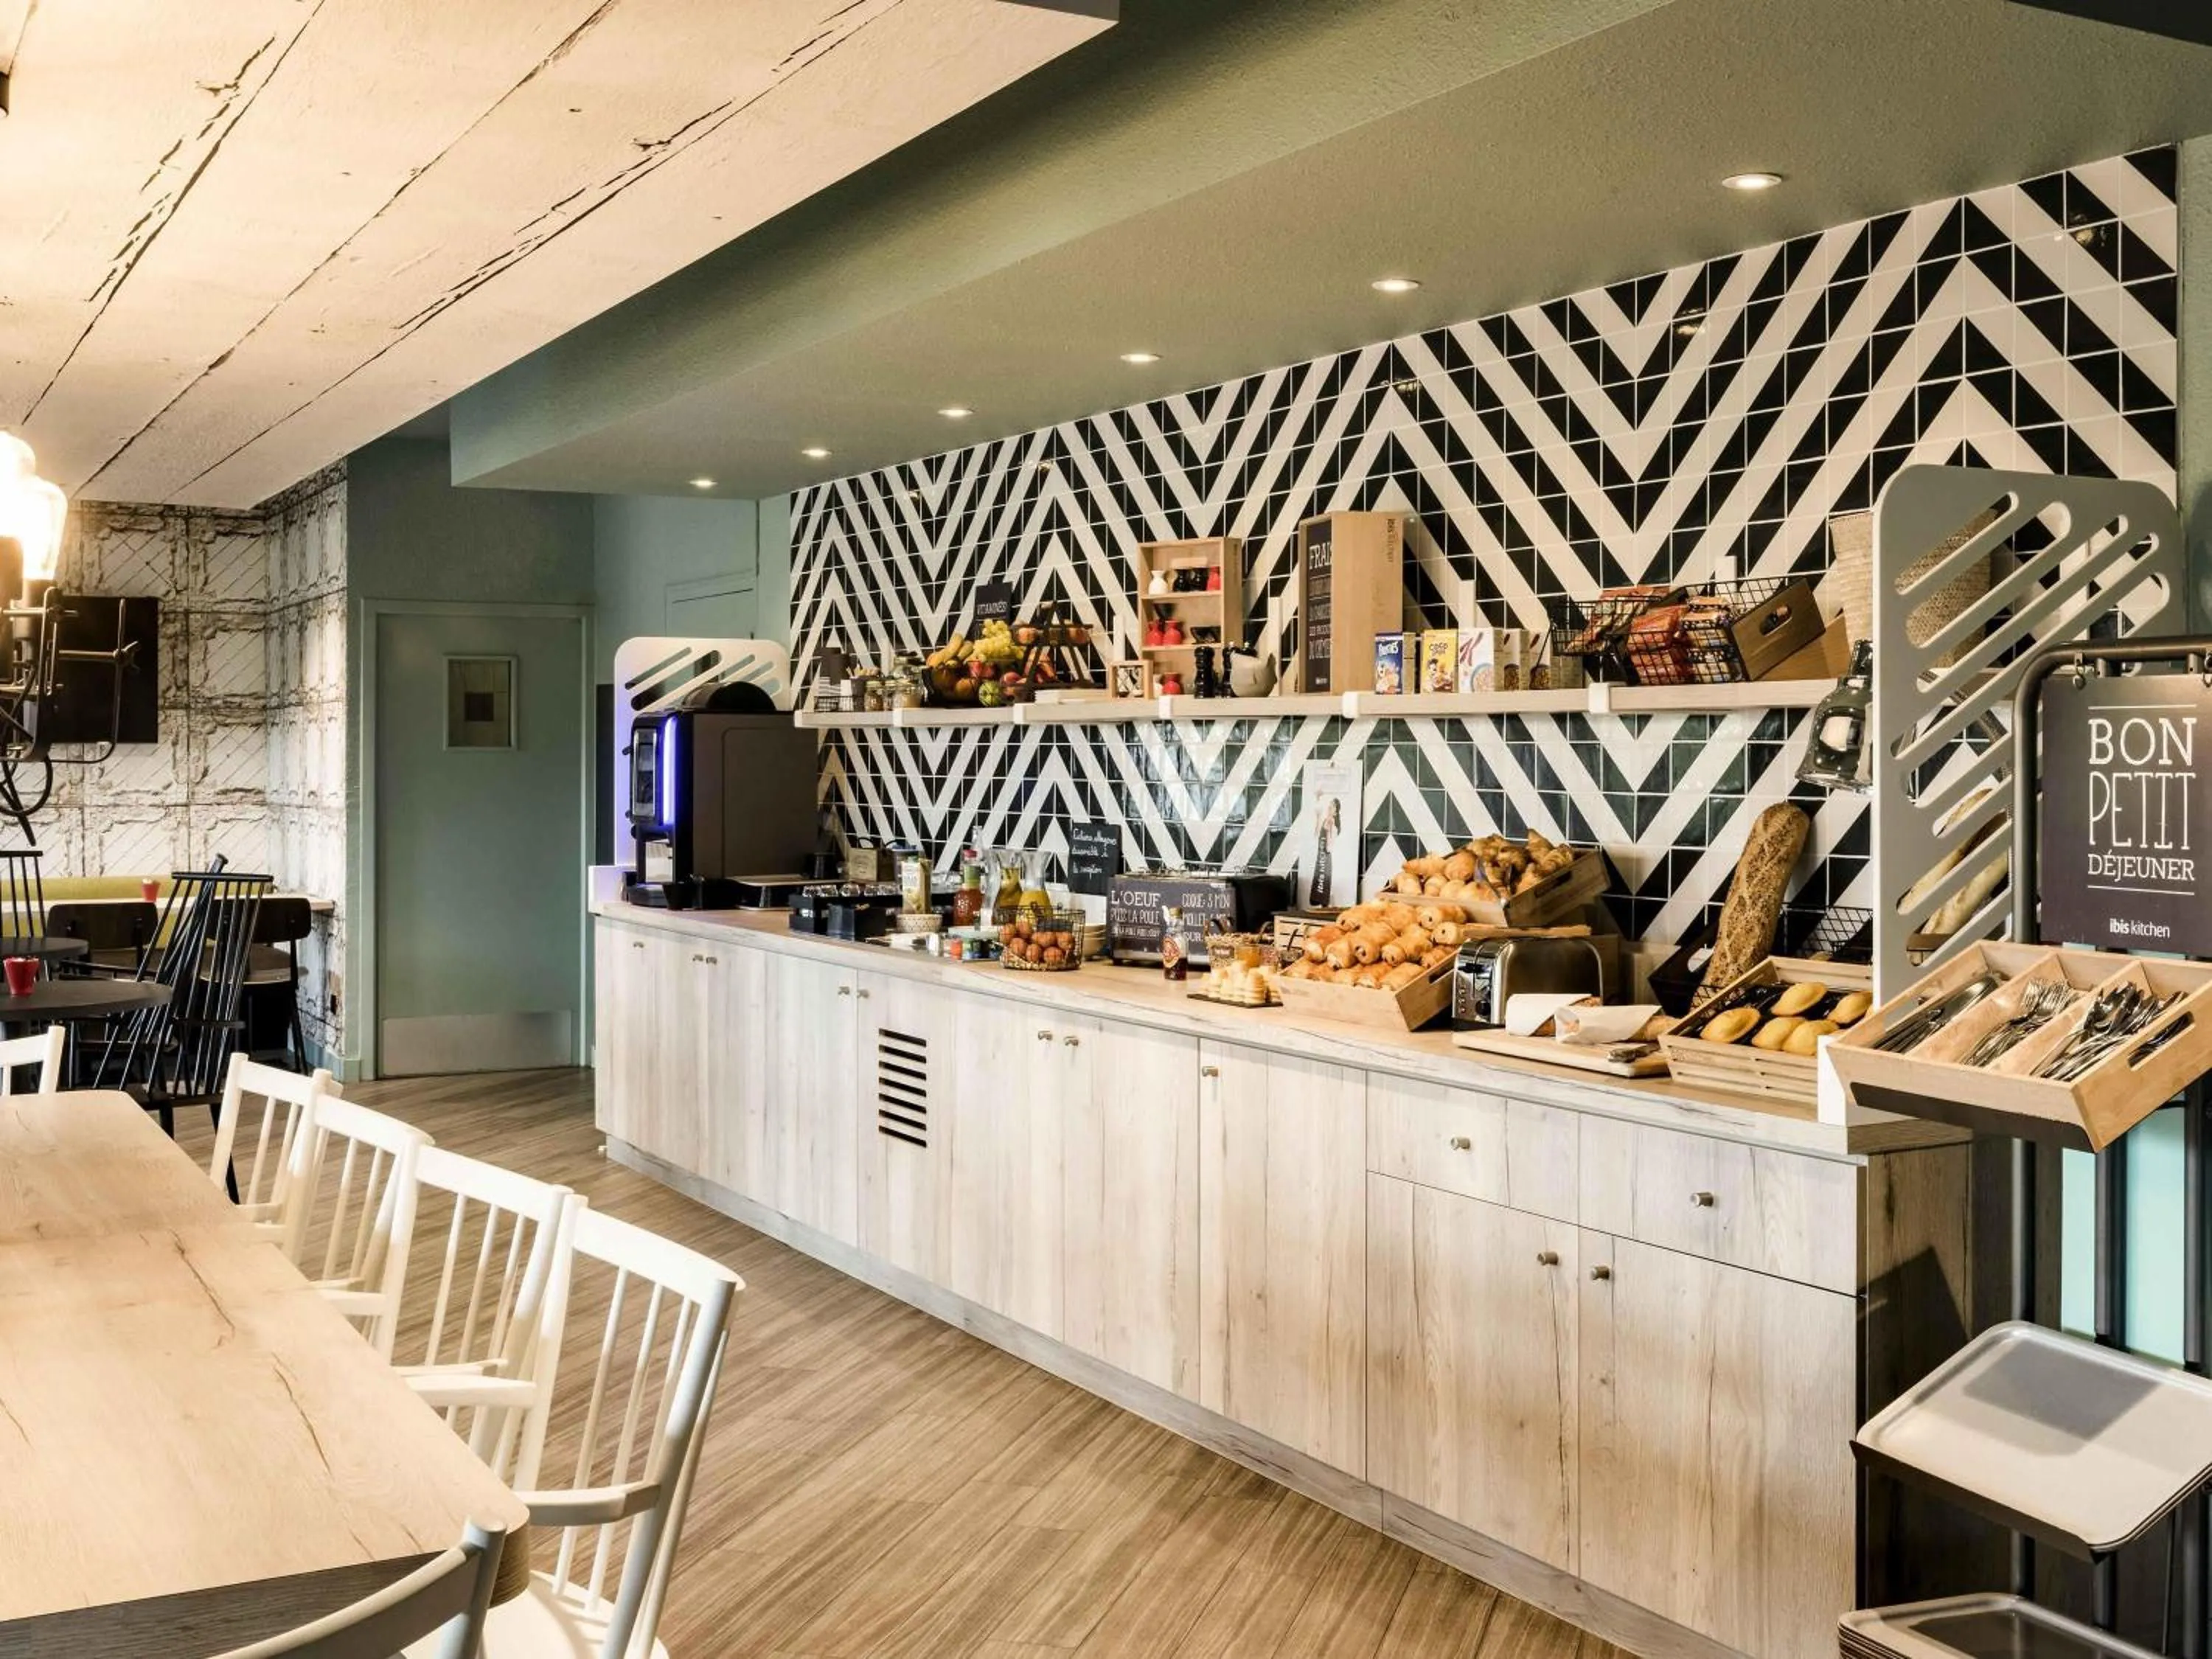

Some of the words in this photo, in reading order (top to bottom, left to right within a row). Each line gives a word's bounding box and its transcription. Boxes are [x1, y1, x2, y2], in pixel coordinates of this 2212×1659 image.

[2088, 717, 2197, 765] BON
[2089, 771, 2197, 850] PETIT
[2088, 849, 2195, 882] DÉJEUNER
[2110, 918, 2129, 934] ibis
[2130, 920, 2170, 938] kitchen
